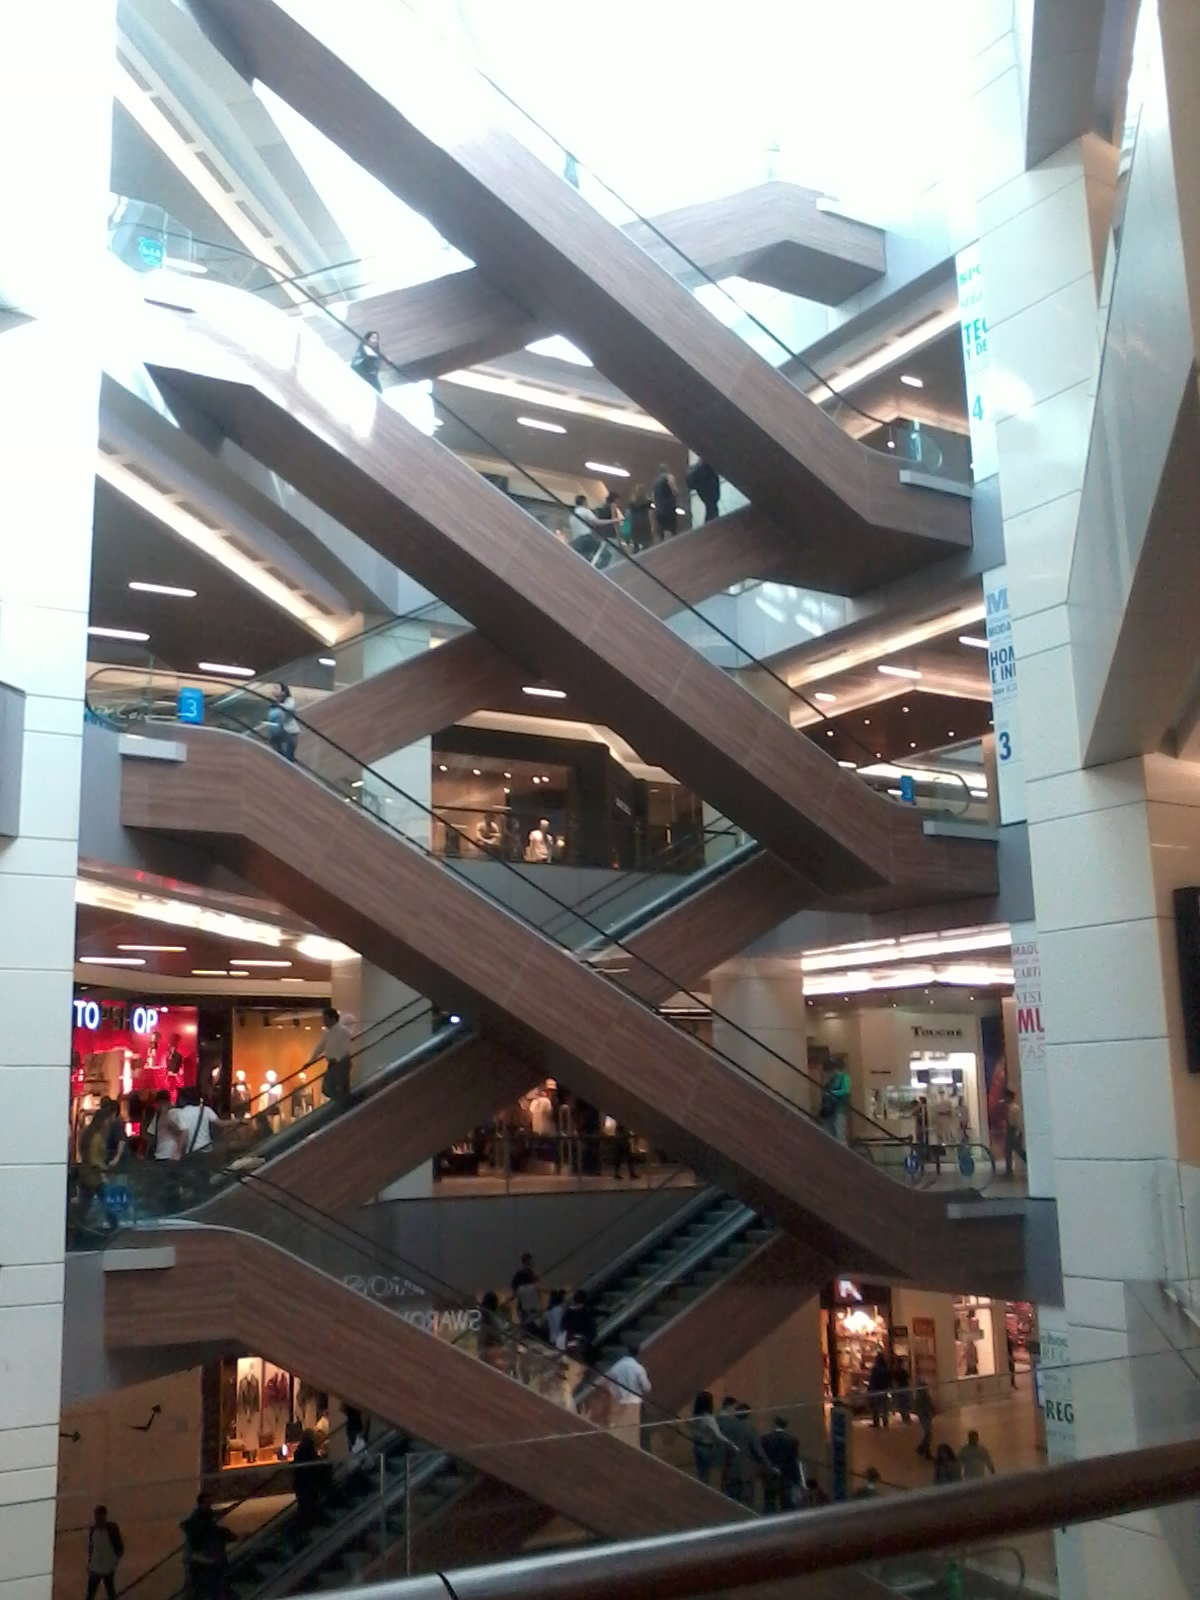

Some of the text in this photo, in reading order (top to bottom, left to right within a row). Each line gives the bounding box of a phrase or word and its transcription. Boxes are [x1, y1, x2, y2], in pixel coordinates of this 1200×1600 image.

[972, 395, 984, 421] 4
[986, 587, 1009, 616] M
[186, 699, 197, 718] 3
[999, 731, 1012, 761] 3
[1045, 1400, 1074, 1424] REG
